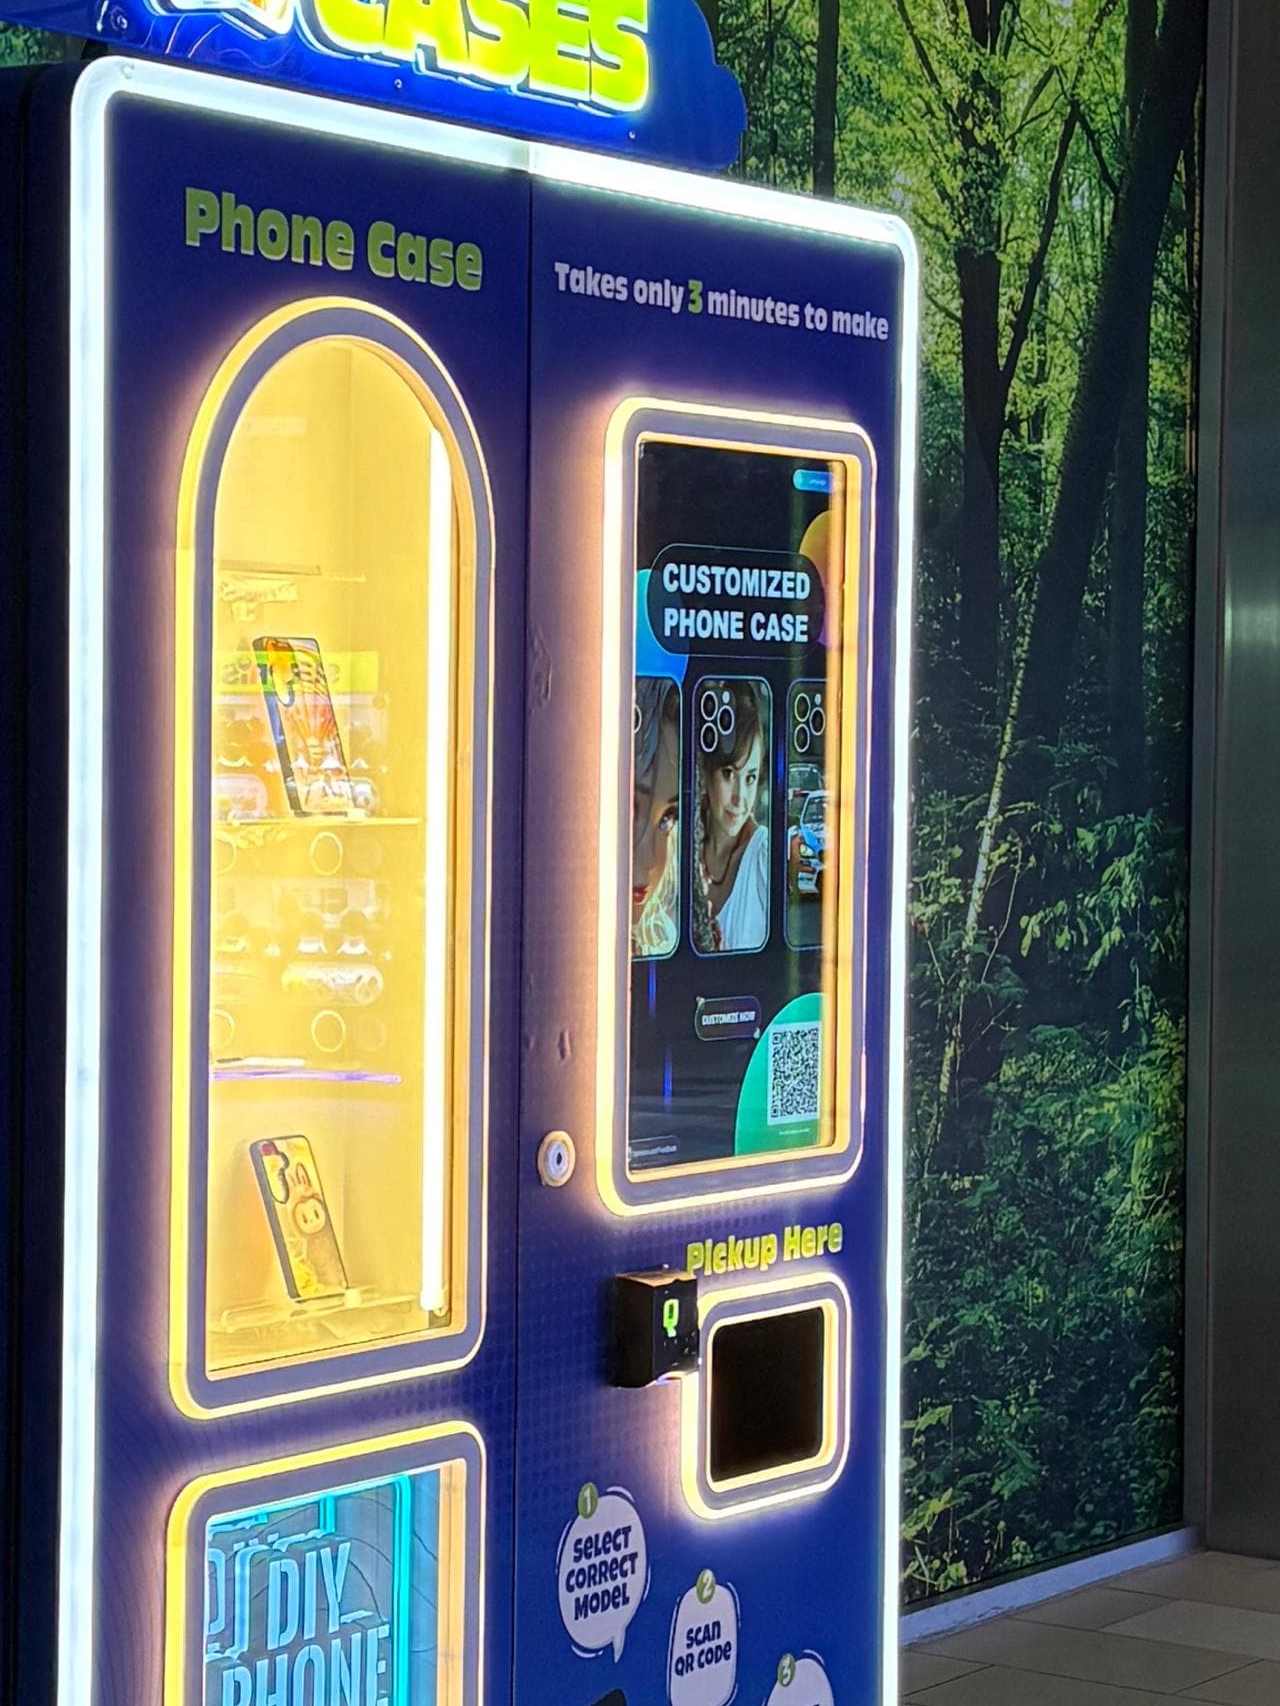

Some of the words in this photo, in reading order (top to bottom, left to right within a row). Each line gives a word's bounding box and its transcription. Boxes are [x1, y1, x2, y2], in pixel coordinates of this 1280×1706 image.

[186, 187, 354, 272] Phone
[367, 221, 484, 291] Case
[554, 262, 628, 301] Takes
[633, 280, 684, 314] only
[687, 280, 703, 314] 3
[708, 290, 800, 328] minutes
[804, 302, 829, 332] to
[832, 311, 889, 341] make
[663, 563, 811, 601] CUSTOMIZED
[664, 608, 744, 640] PHONE
[750, 612, 809, 643] CASE
[686, 1232, 778, 1276] Pickup
[783, 1222, 843, 1261] Here
[267, 1542, 351, 1650] DIY
[674, 1651, 696, 1677] QR
